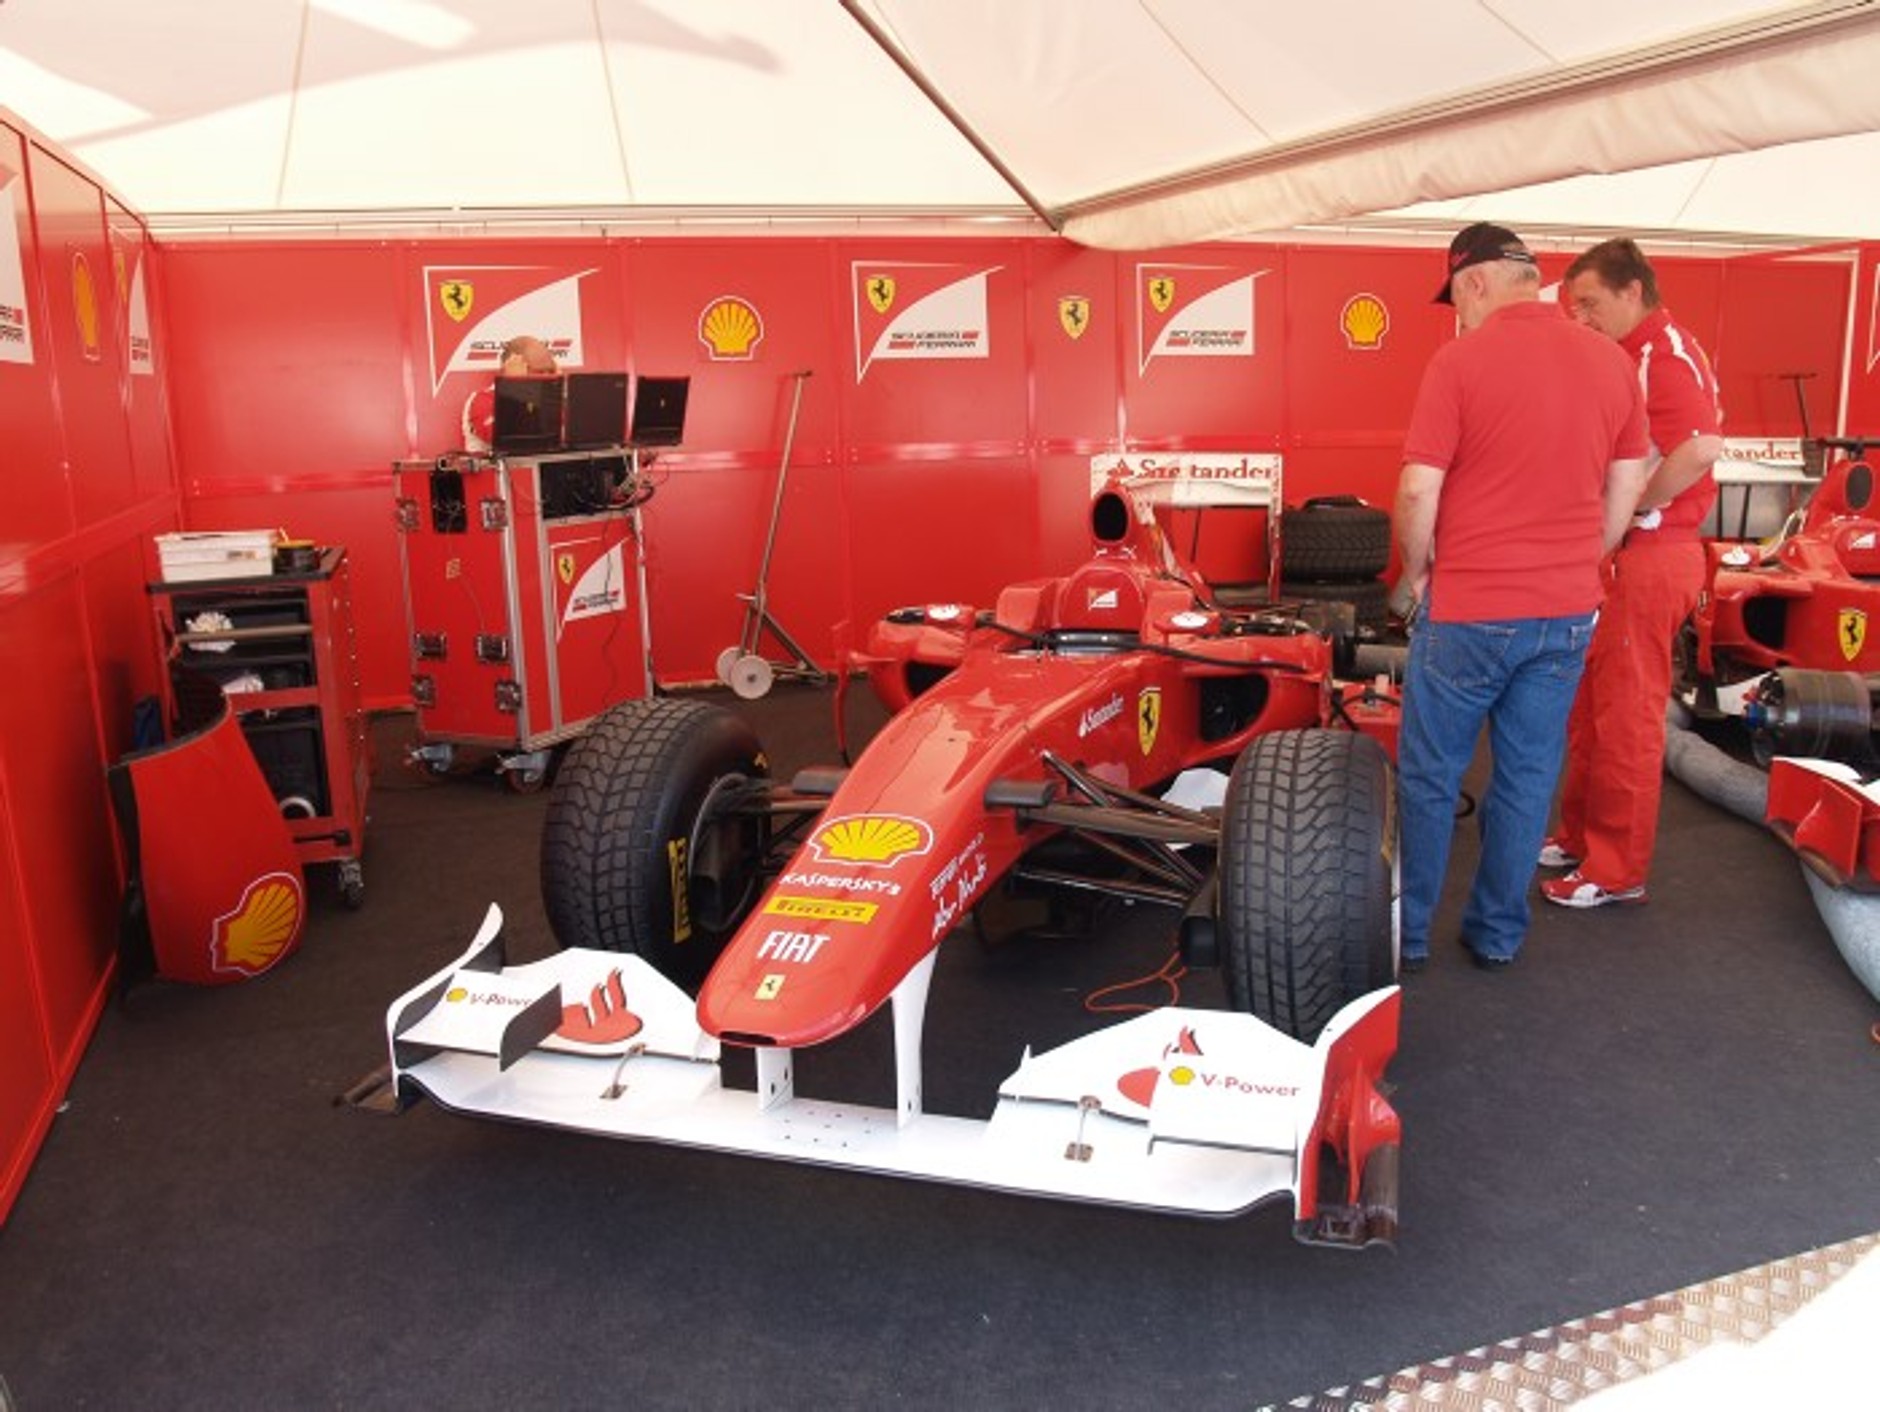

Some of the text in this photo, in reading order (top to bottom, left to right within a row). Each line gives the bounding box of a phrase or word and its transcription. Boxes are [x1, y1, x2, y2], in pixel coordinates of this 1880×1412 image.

[1721, 441, 1800, 459] tander
[758, 931, 831, 963] FIAT
[1200, 1073, 1300, 1097] V-Power
